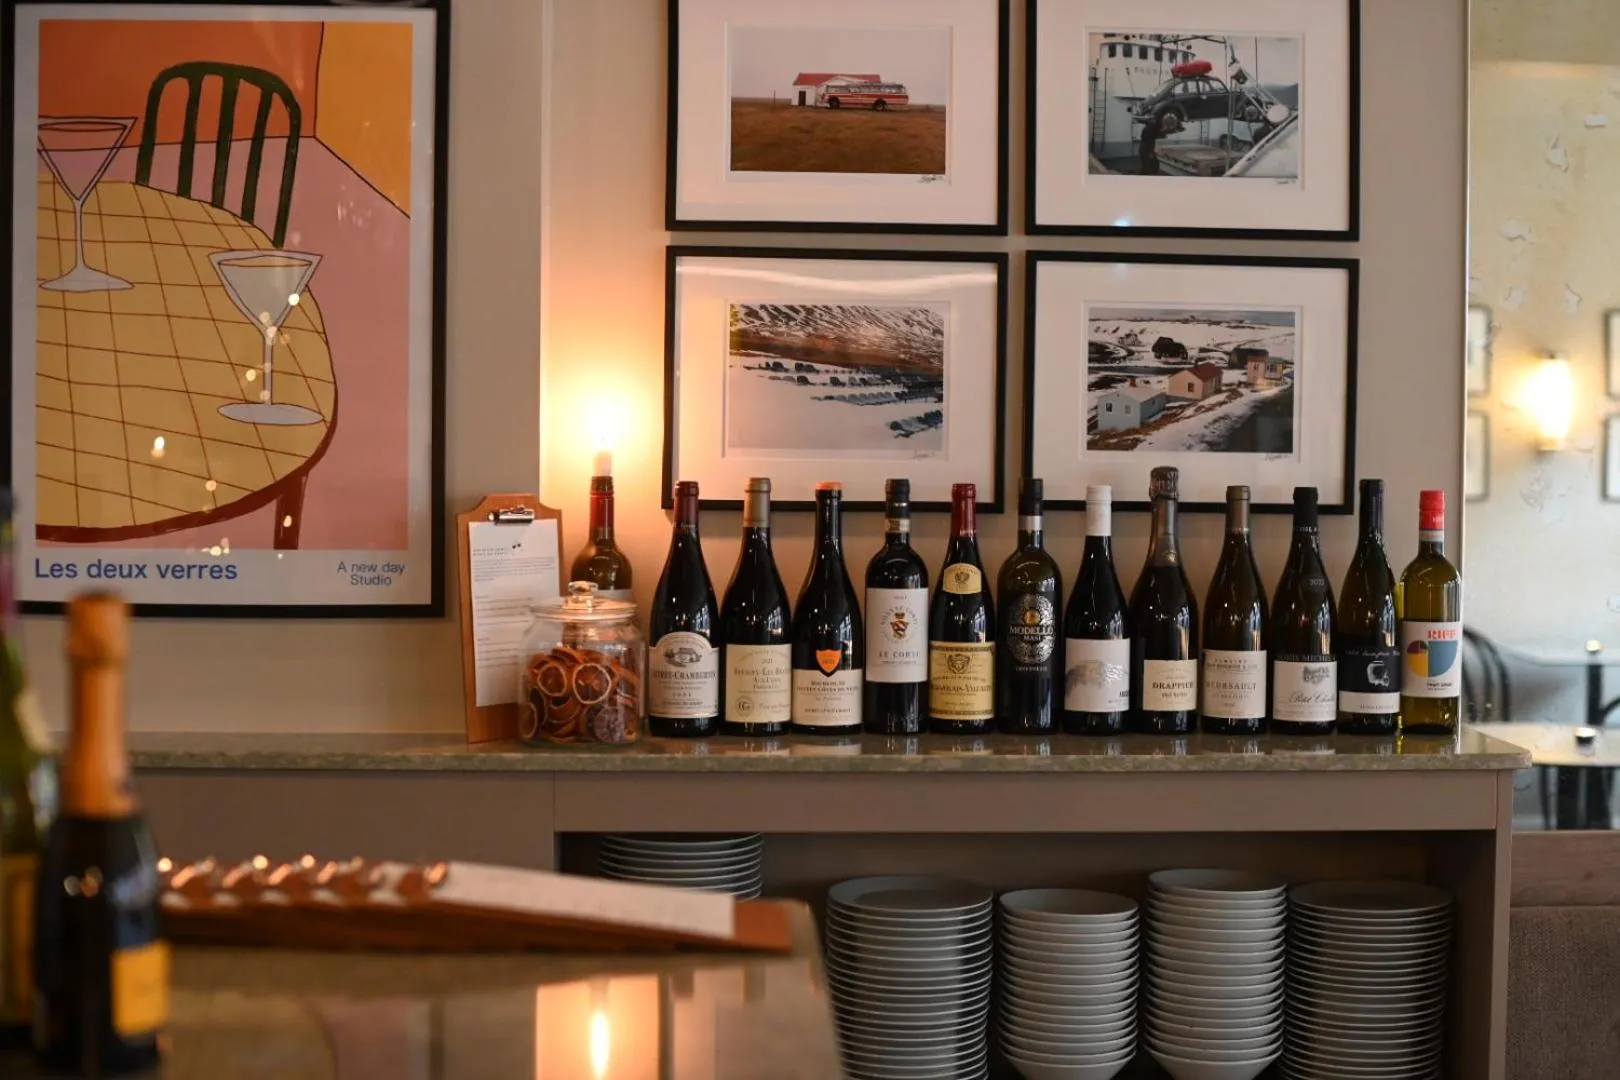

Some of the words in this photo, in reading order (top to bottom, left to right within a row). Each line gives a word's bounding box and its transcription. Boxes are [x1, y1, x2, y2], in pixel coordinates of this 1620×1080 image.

[35, 558, 78, 579] Les
[86, 559, 148, 579] deux
[156, 563, 238, 580] verres
[336, 561, 347, 574] A
[351, 563, 378, 573] new
[382, 561, 406, 576] day
[350, 573, 392, 586] Studio
